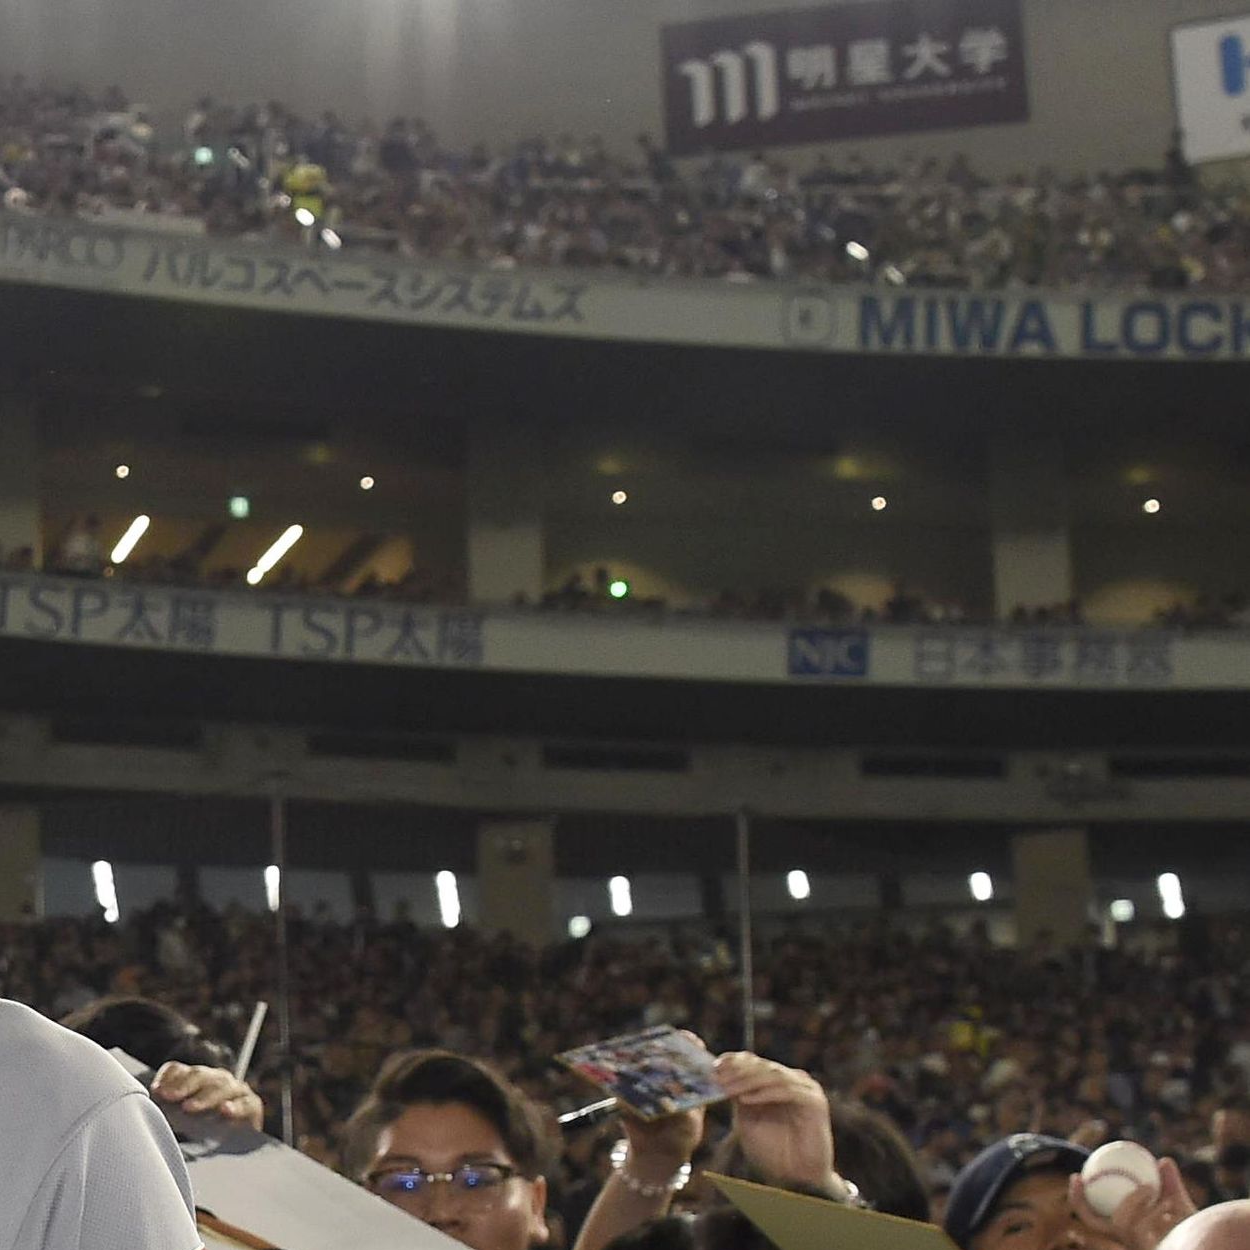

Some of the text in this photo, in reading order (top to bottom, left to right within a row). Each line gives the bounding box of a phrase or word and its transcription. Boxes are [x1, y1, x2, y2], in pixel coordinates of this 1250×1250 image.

[787, 27, 1008, 89] 明星大学
[856, 295, 1054, 355] MIWA
